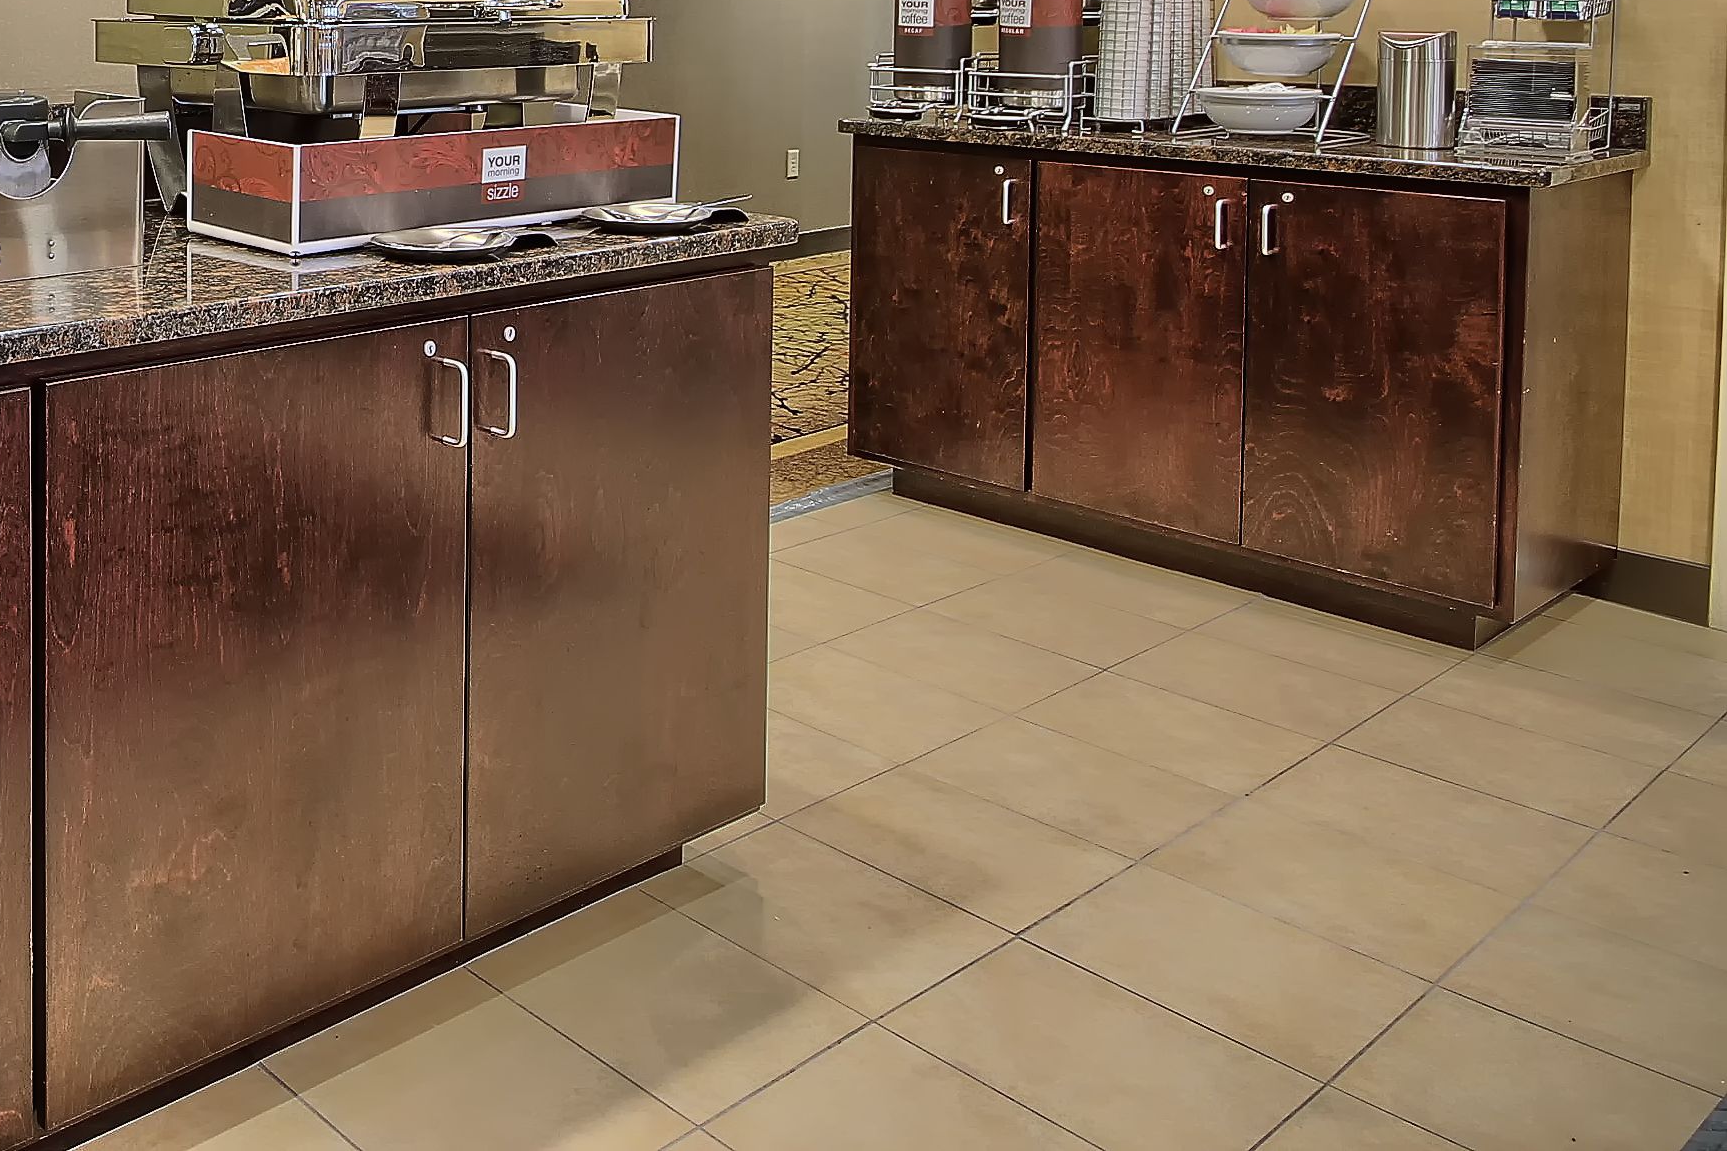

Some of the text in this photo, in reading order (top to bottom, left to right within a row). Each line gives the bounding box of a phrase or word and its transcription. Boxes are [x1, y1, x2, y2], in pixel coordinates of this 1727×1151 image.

[901, 0, 929, 8] YOUR
[1001, 0, 1026, 8] YOUR
[901, 13, 928, 24] coffee
[1001, 12, 1025, 24] coffee
[487, 155, 521, 168] YOUR
[487, 167, 520, 177] morning
[486, 182, 519, 201] sizzle
